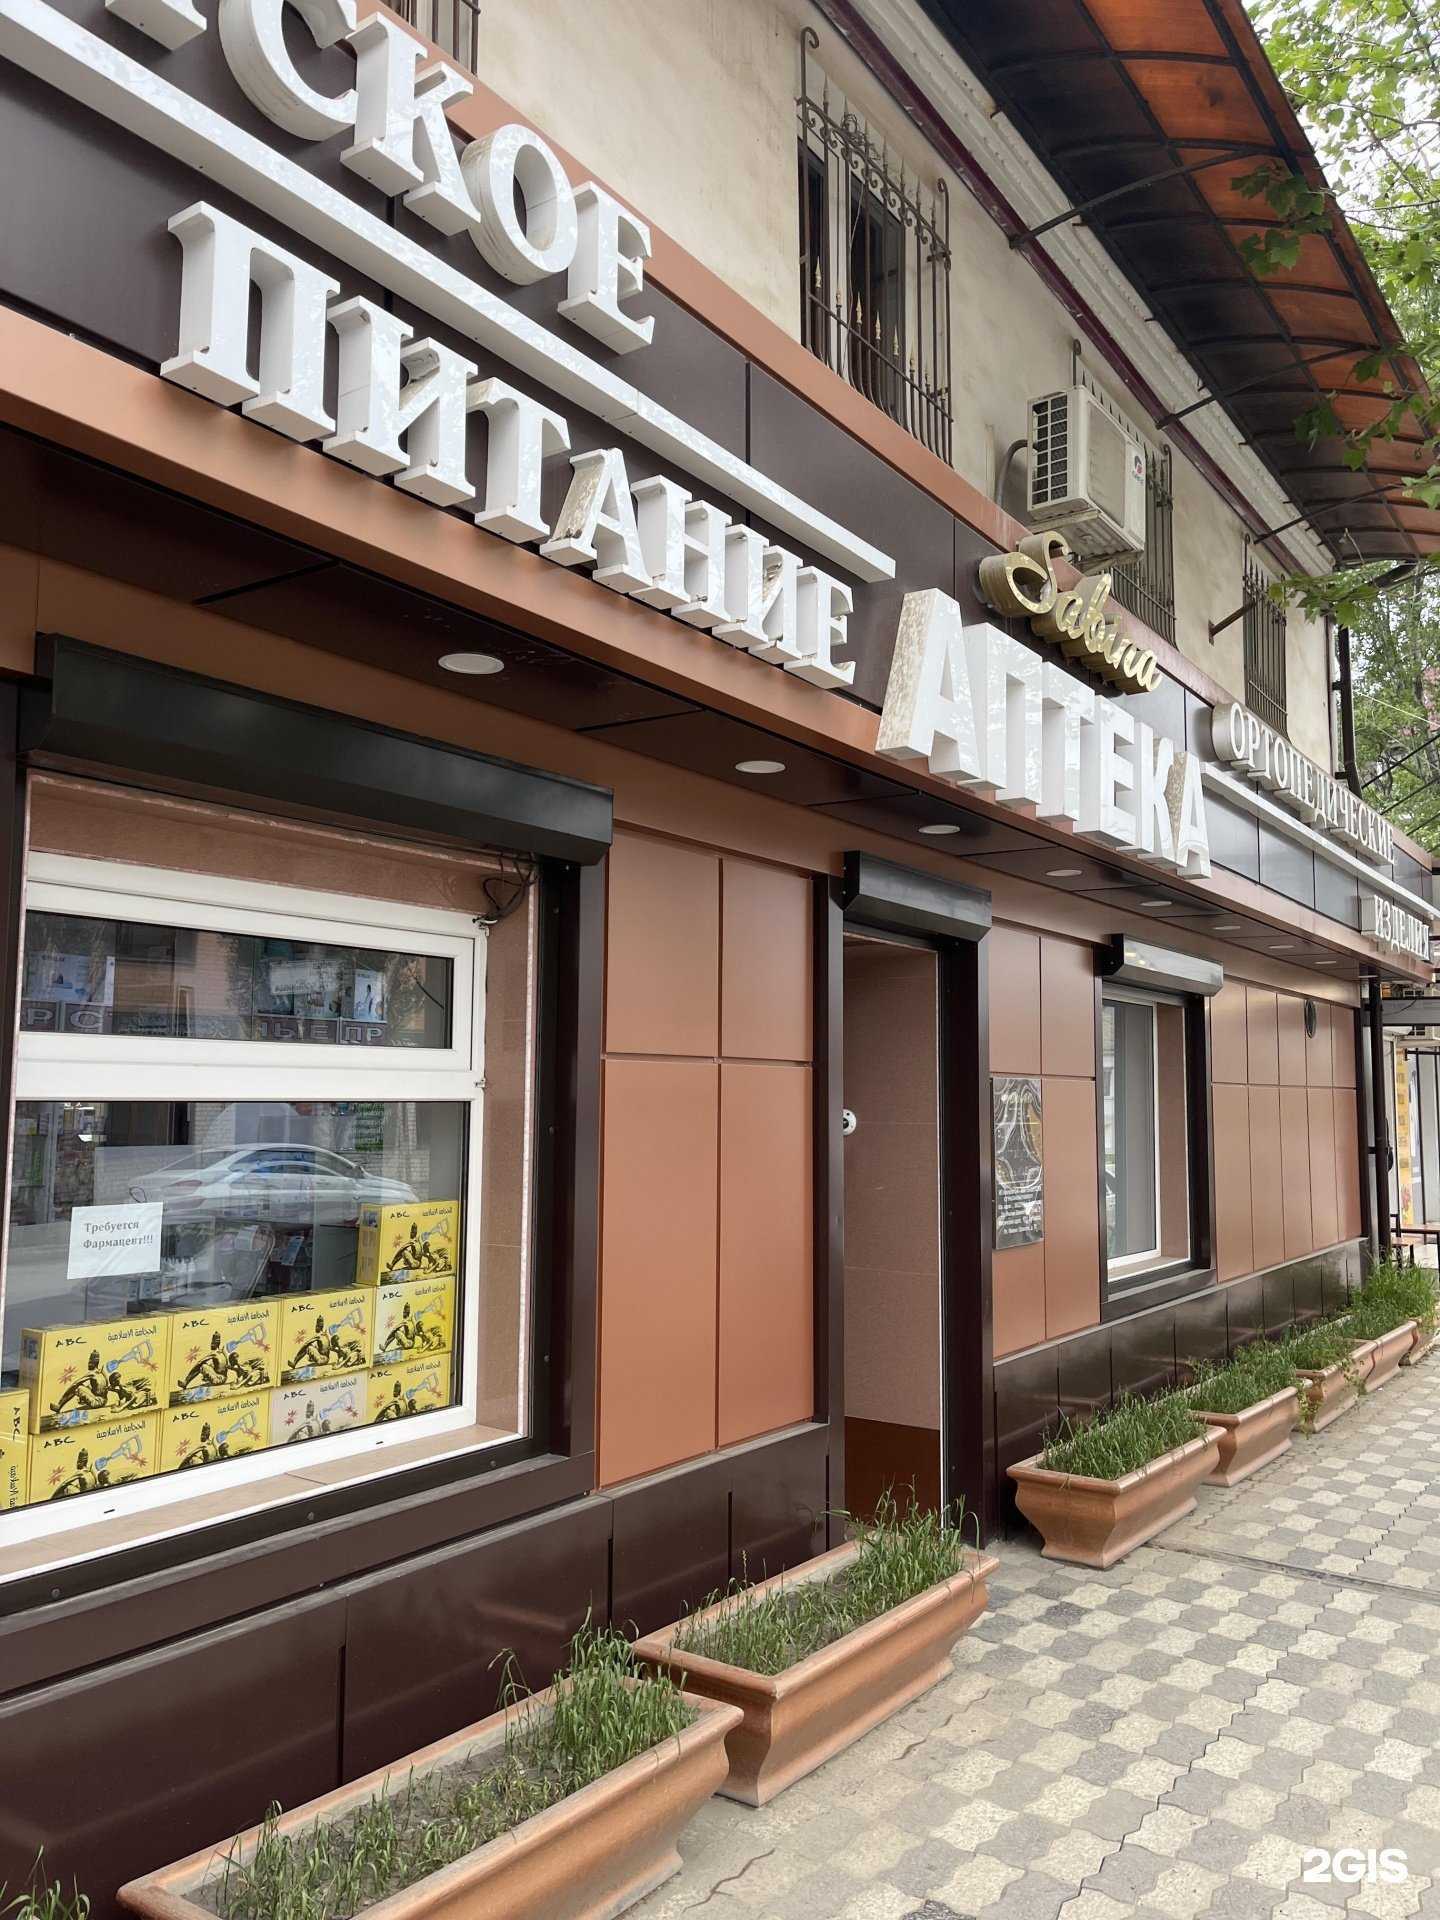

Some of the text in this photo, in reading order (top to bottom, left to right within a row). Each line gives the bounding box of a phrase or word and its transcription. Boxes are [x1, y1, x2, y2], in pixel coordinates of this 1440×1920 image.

[107, 0, 654, 354] СКОЕ
[160, 201, 856, 689] ПИТАНИЕ
[981, 531, 1163, 695] Sabina
[875, 588, 1211, 878] АПТЕКА
[1212, 702, 1395, 865] ОРТОПЕДИЧЕСКИЕ
[1362, 895, 1430, 961] ИЗДЕЛИЯ
[390, 1211, 410, 1219] ABC
[83, 1221, 139, 1235] Требуется
[382, 1291, 402, 1300] ABC
[291, 1303, 315, 1312] ABC
[182, 1319, 209, 1329] ABC
[55, 1336, 87, 1348] ABC
[369, 1370, 392, 1379] ABC
[283, 1389, 306, 1400] ABC
[172, 1411, 199, 1422] ABC
[44, 1435, 76, 1448] ABC
